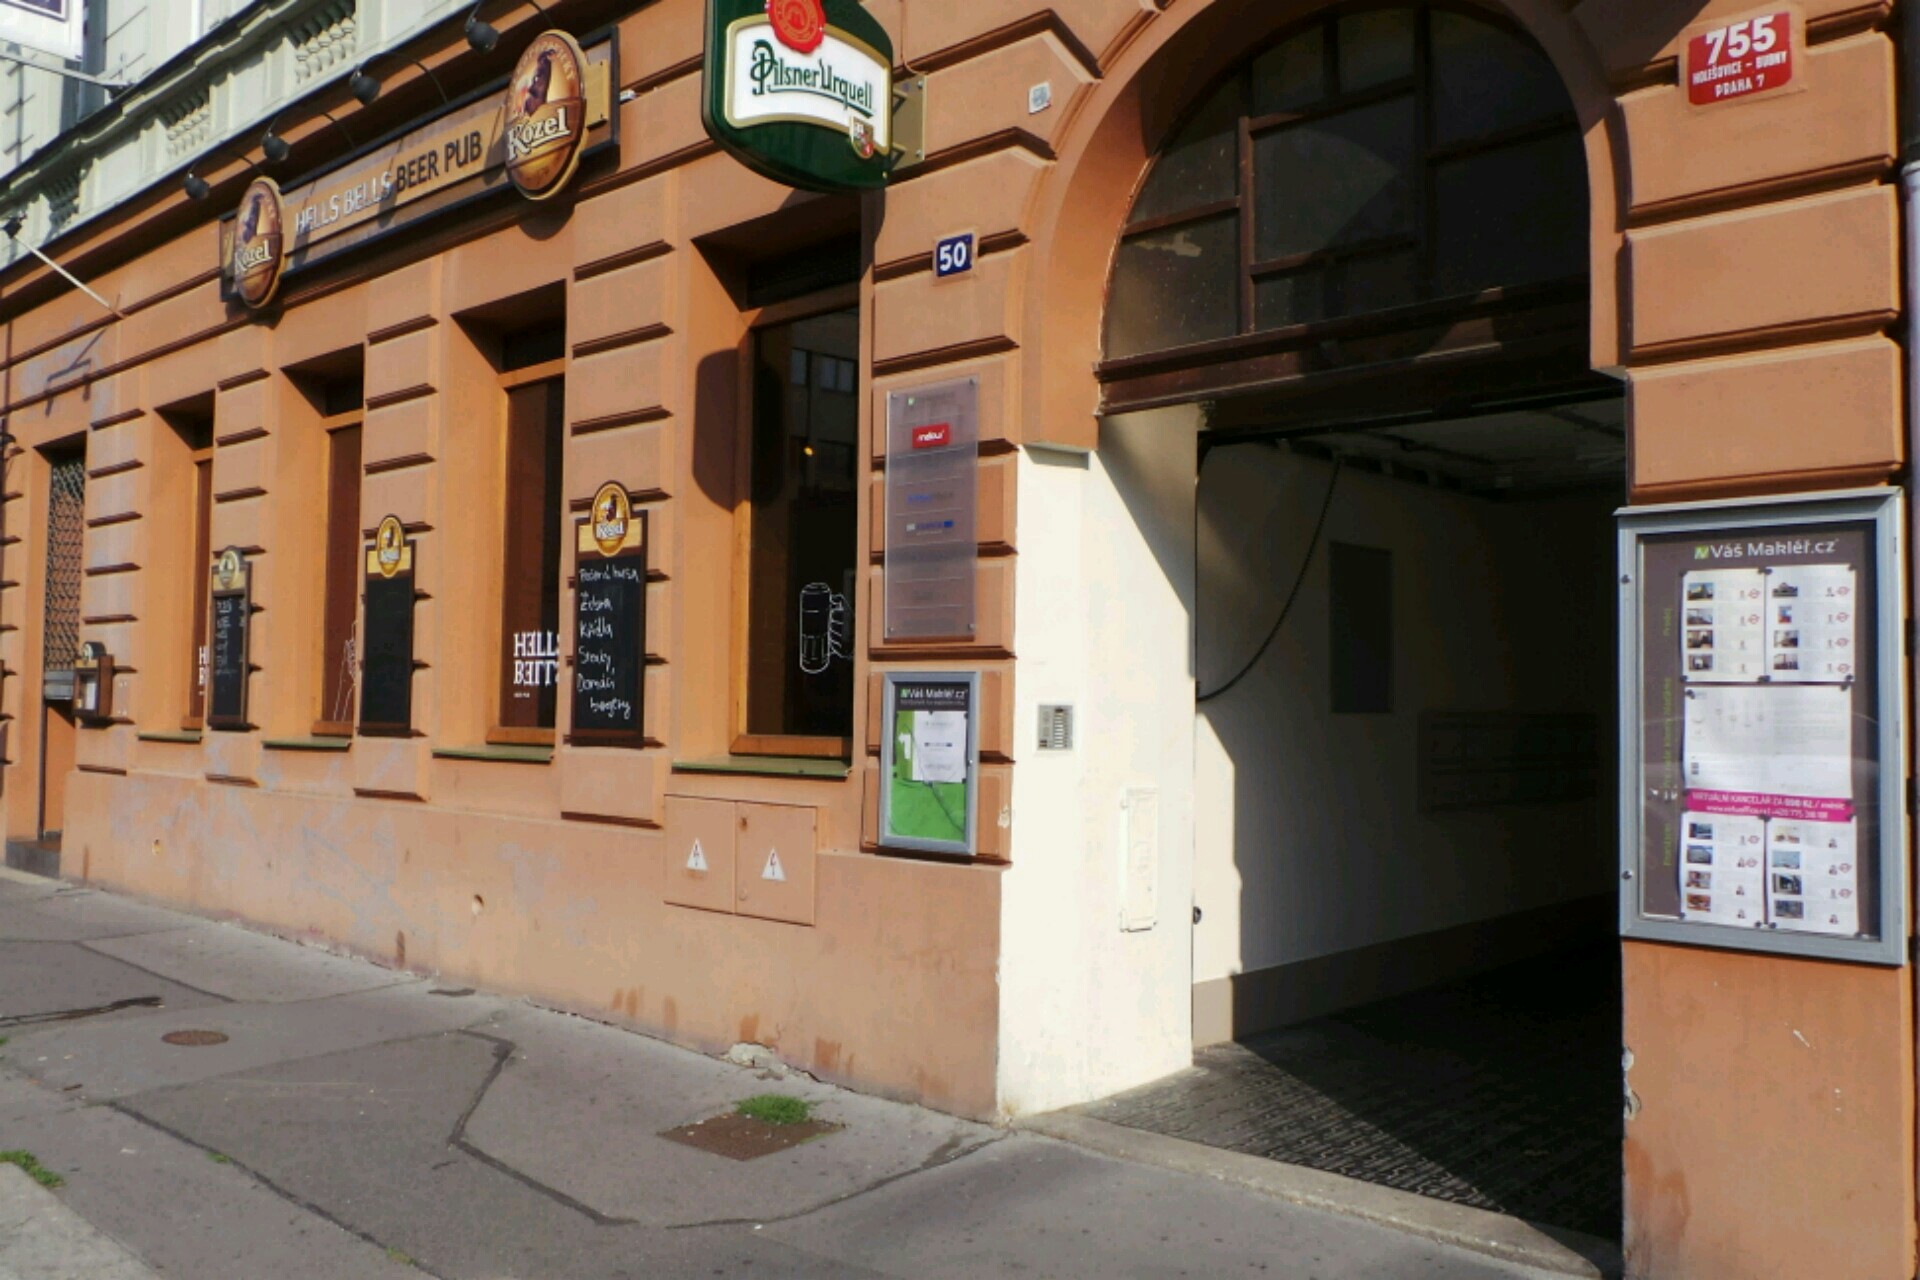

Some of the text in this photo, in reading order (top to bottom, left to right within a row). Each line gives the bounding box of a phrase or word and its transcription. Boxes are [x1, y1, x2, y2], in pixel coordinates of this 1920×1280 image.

[1706, 15, 1777, 66] 755
[750, 39, 873, 111] Pilsner Urquell
[1692, 61, 1742, 85] HOLEŠOVICE
[1715, 73, 1765, 97] PRAHA 7
[507, 106, 571, 160] Kozel
[295, 130, 482, 235] HELLS BELLS BEER PUB
[234, 240, 273, 275] Kozel
[940, 241, 967, 271] 50
[1710, 543, 1743, 559] Váš
